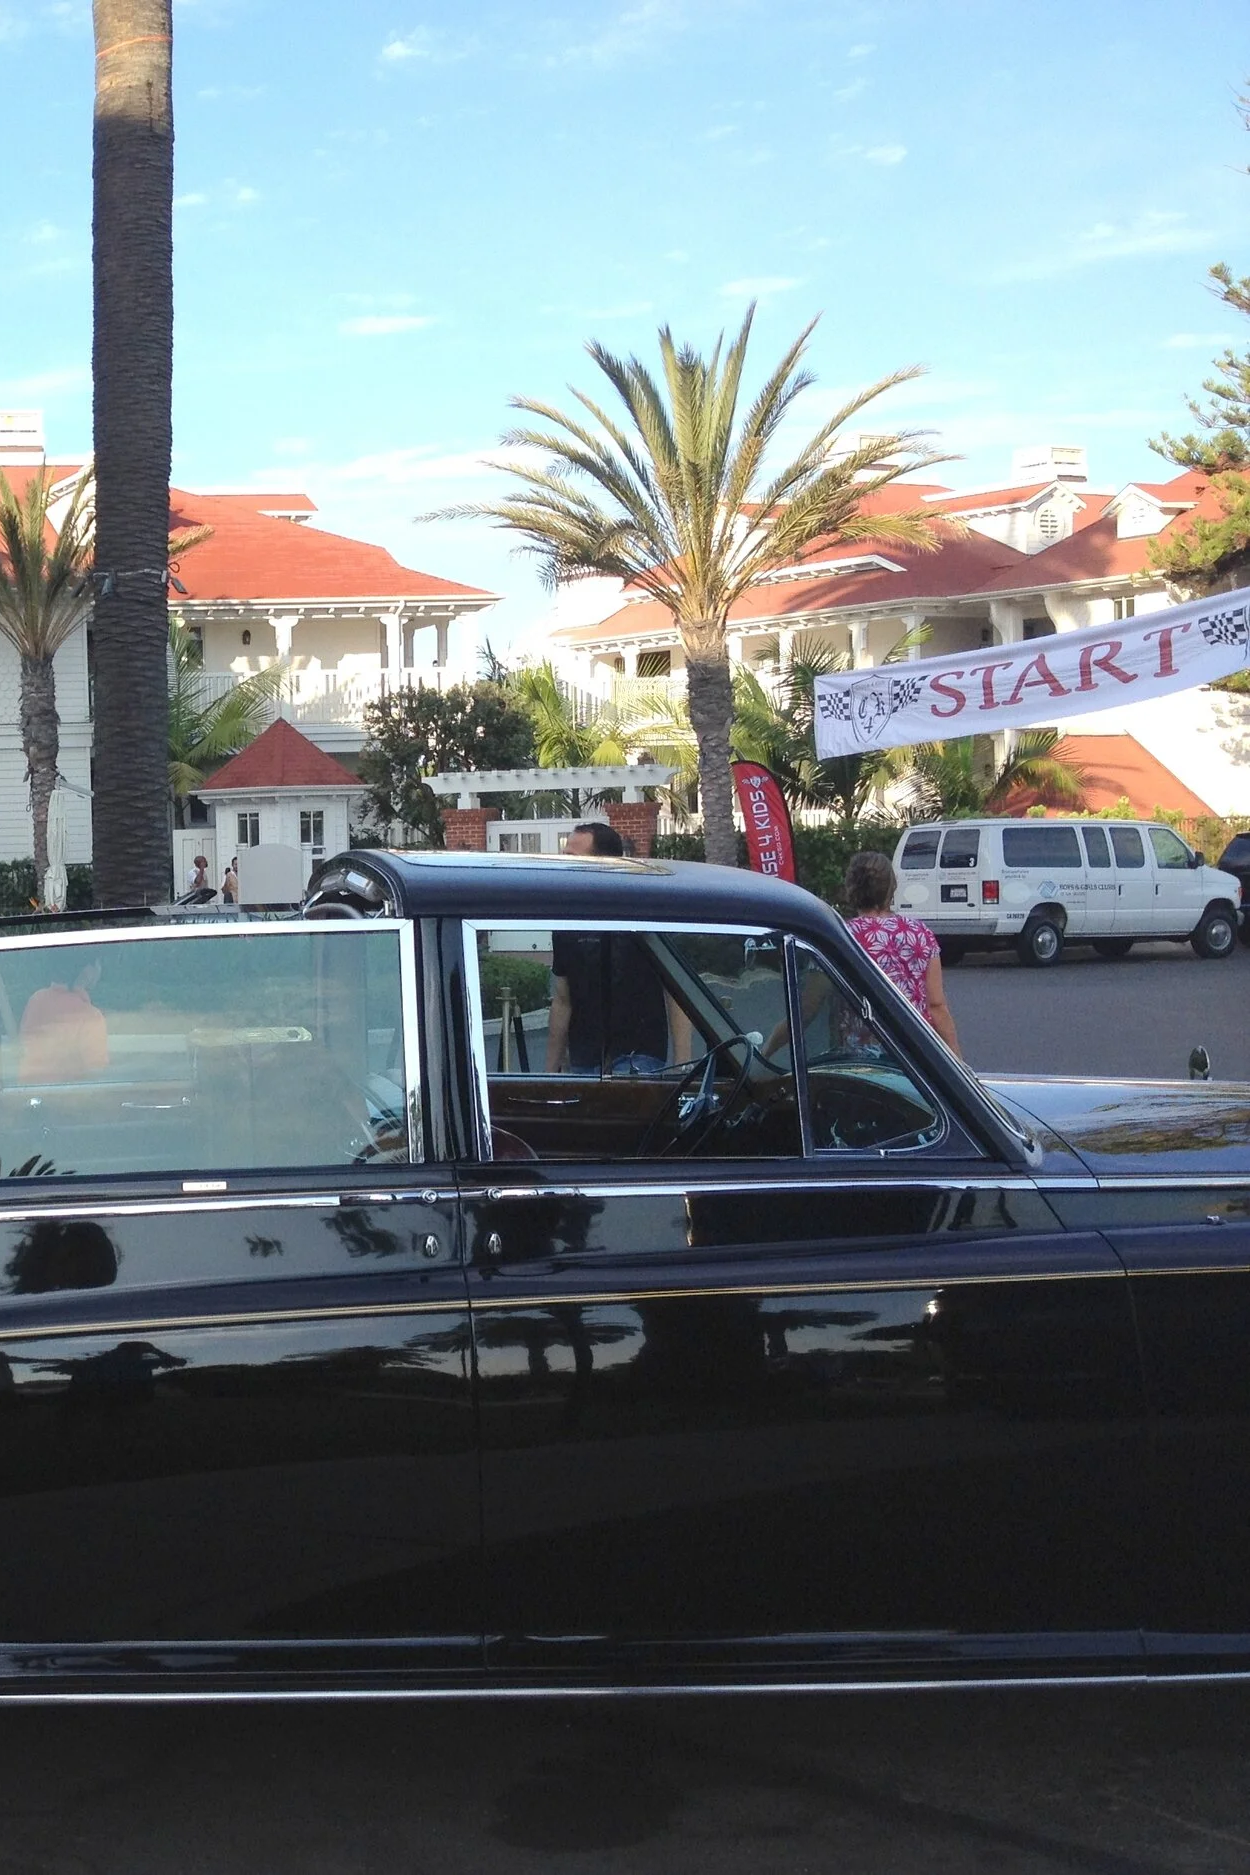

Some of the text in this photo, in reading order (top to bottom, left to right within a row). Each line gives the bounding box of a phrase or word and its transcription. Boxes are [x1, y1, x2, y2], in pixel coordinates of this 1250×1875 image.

[929, 622, 1192, 718] START
[750, 790, 771, 830] KIDS
[758, 835, 773, 847] 4
